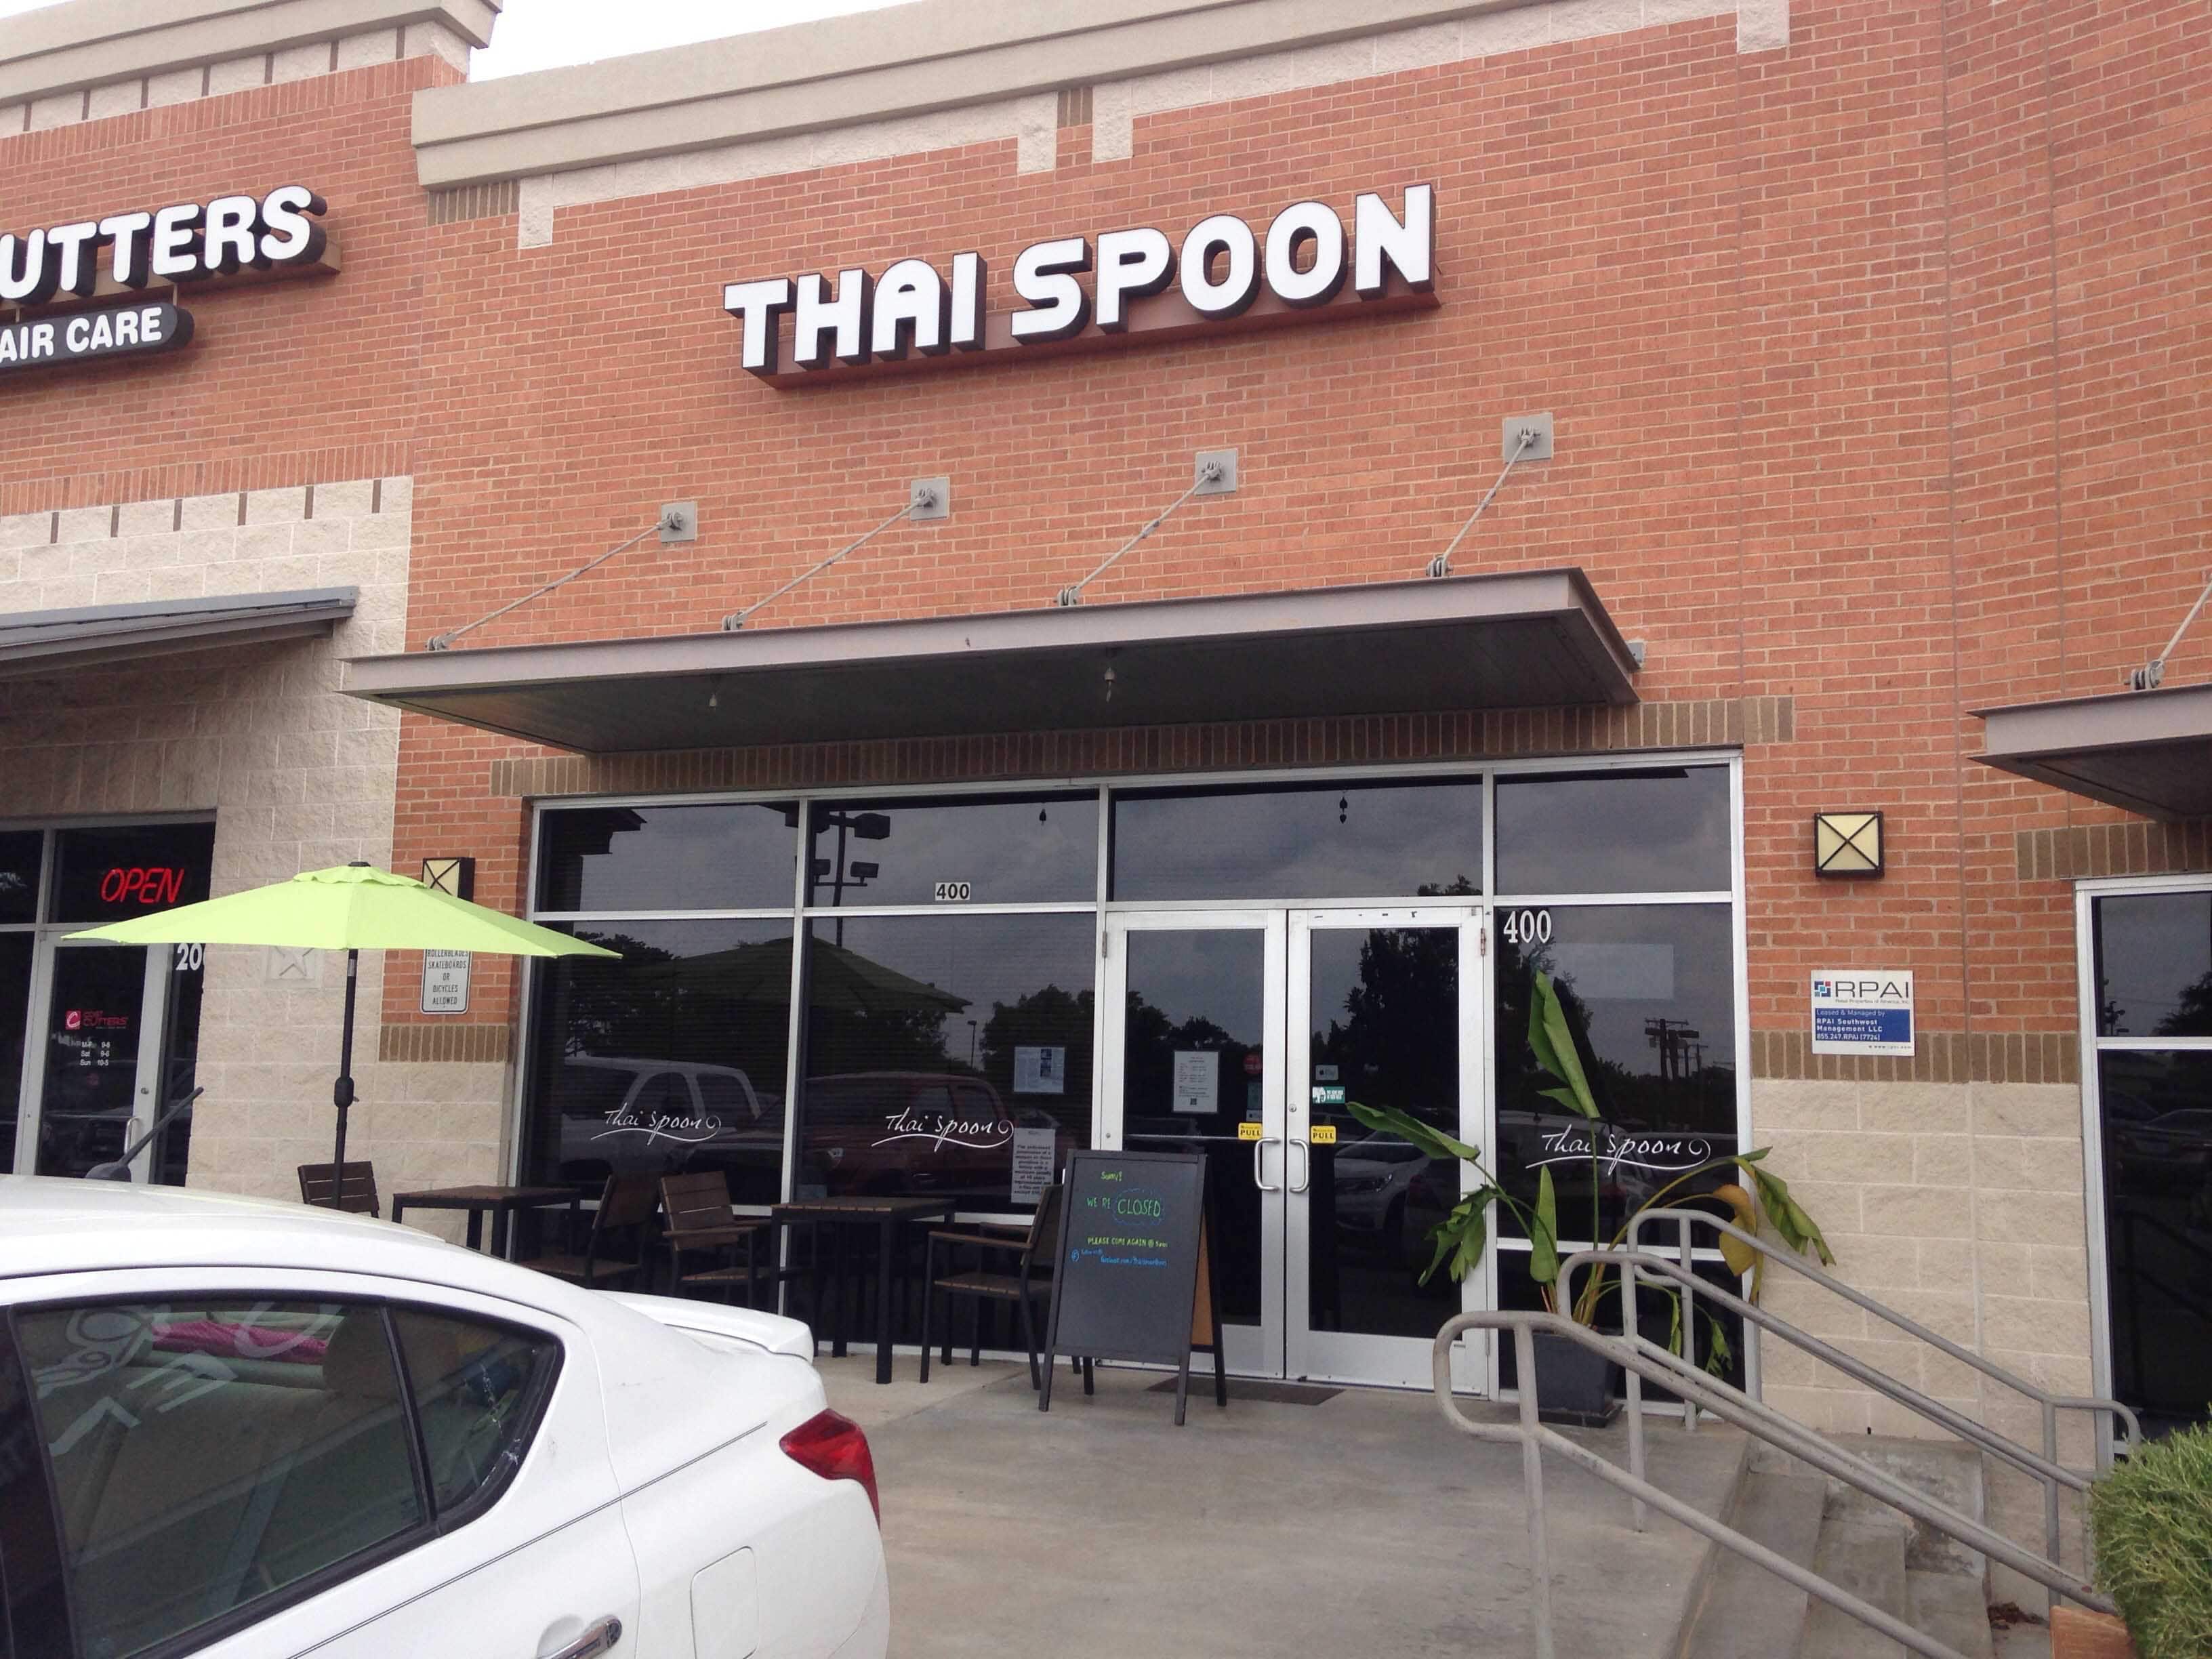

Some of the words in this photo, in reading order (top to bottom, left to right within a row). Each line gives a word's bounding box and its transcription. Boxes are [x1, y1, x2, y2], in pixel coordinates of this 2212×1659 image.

[0, 185, 312, 300] UTTERS
[723, 251, 982, 369] THAI
[1010, 184, 1435, 340] SPOON
[0, 323, 54, 364] AIR
[66, 306, 162, 352] CARE
[100, 867, 184, 903] OPEN
[936, 883, 969, 899] 400
[1503, 910, 1551, 943] 400
[176, 943, 205, 970] 20
[428, 960, 467, 969] SKATEBOARDS
[443, 972, 450, 981] OR
[433, 984, 459, 993] BICYCLES
[1835, 981, 1909, 998] RPAI
[432, 997, 457, 1005] ALLOWED
[1847, 1009, 1877, 1017] Managed
[605, 1102, 640, 1126] Thai
[886, 1107, 928, 1132] Thai
[1118, 1199, 1161, 1217] CLOSED
[1087, 1237, 1109, 1245] PLEASE
[1127, 1237, 1147, 1247] AGAIN
